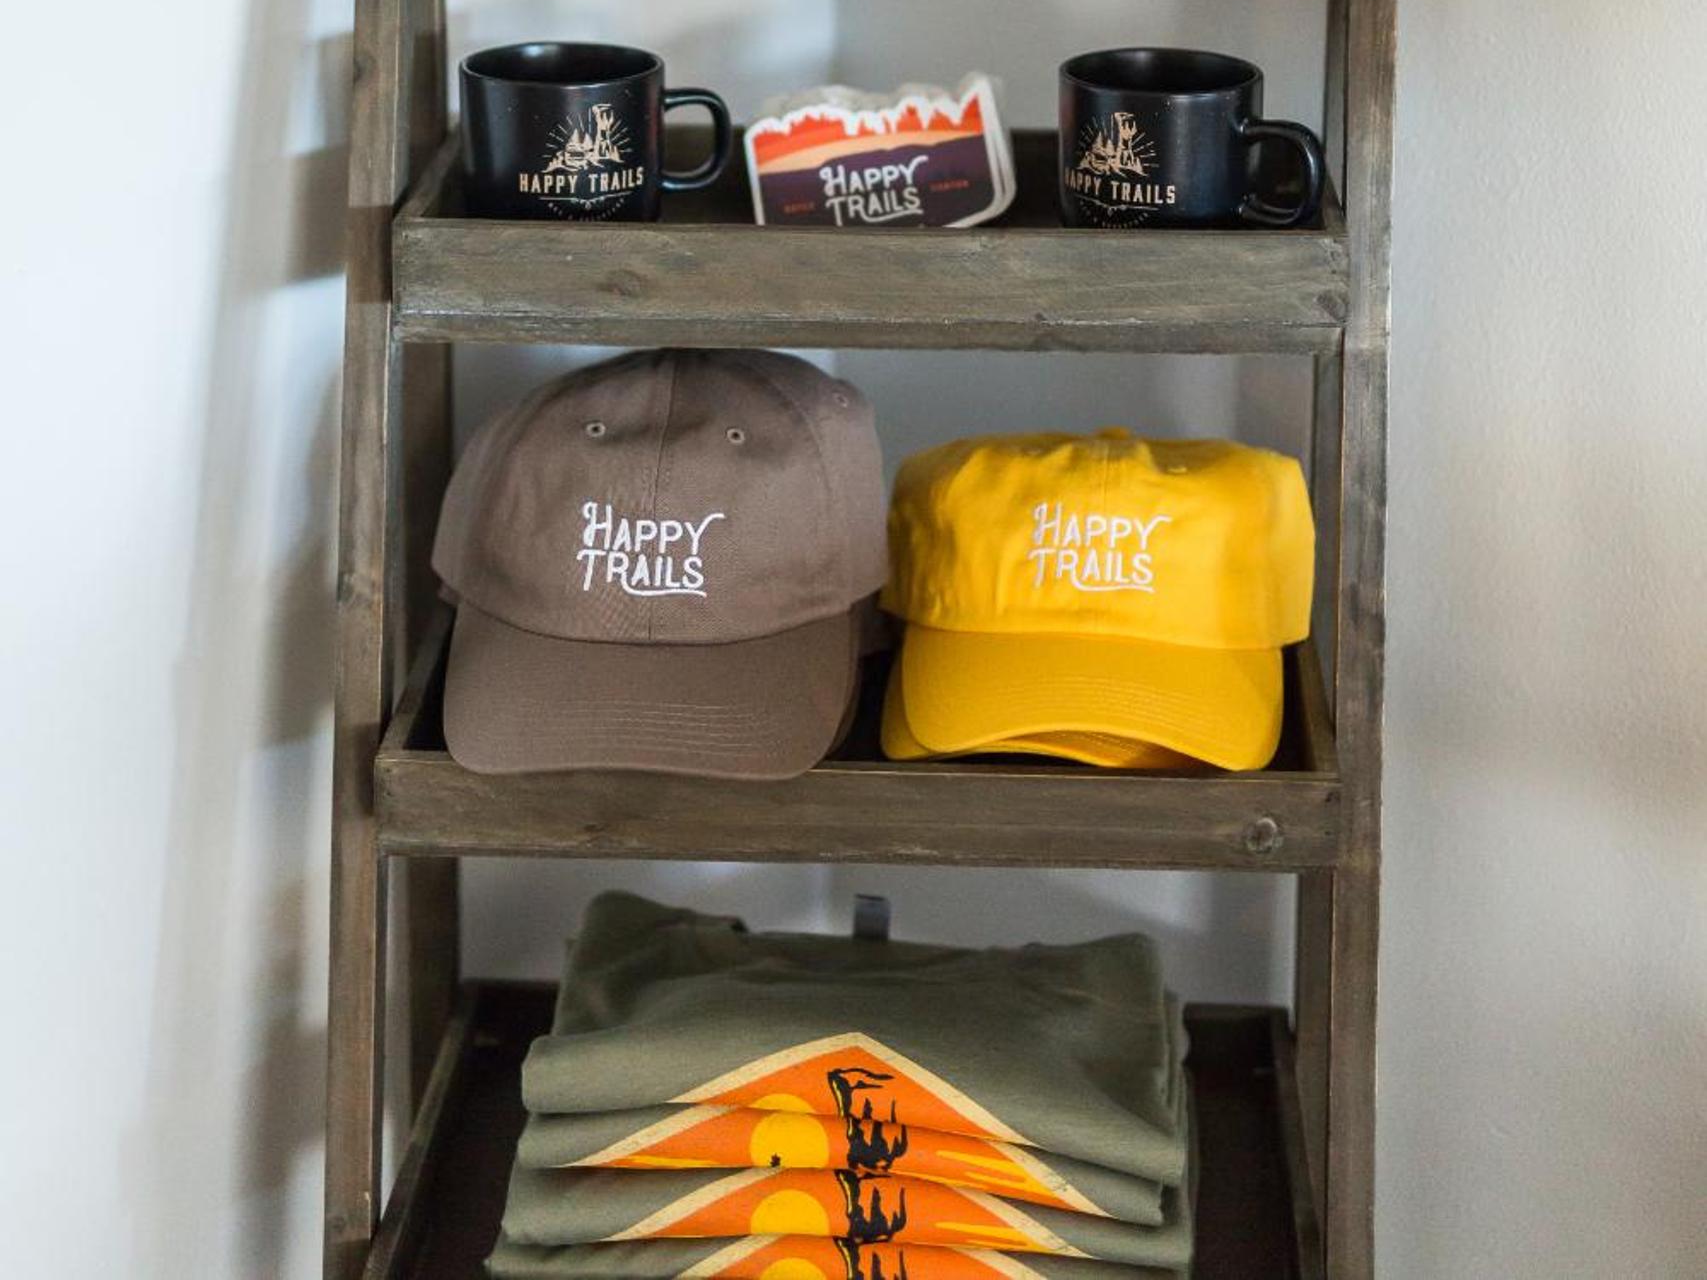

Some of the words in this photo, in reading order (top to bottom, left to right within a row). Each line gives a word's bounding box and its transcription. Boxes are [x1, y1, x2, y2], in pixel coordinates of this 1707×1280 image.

[518, 172, 579, 194] HAPPY
[587, 167, 645, 194] TRAILS
[819, 155, 929, 197] HAPPY
[1064, 167, 1101, 196] HAPPY
[1111, 180, 1177, 205] TRAILS
[825, 186, 925, 227] TRAILS
[582, 501, 726, 556] HAPPY
[1033, 501, 1173, 551] HAPPY
[576, 548, 708, 598] TRAILS
[1027, 546, 1156, 593] TRAILS
